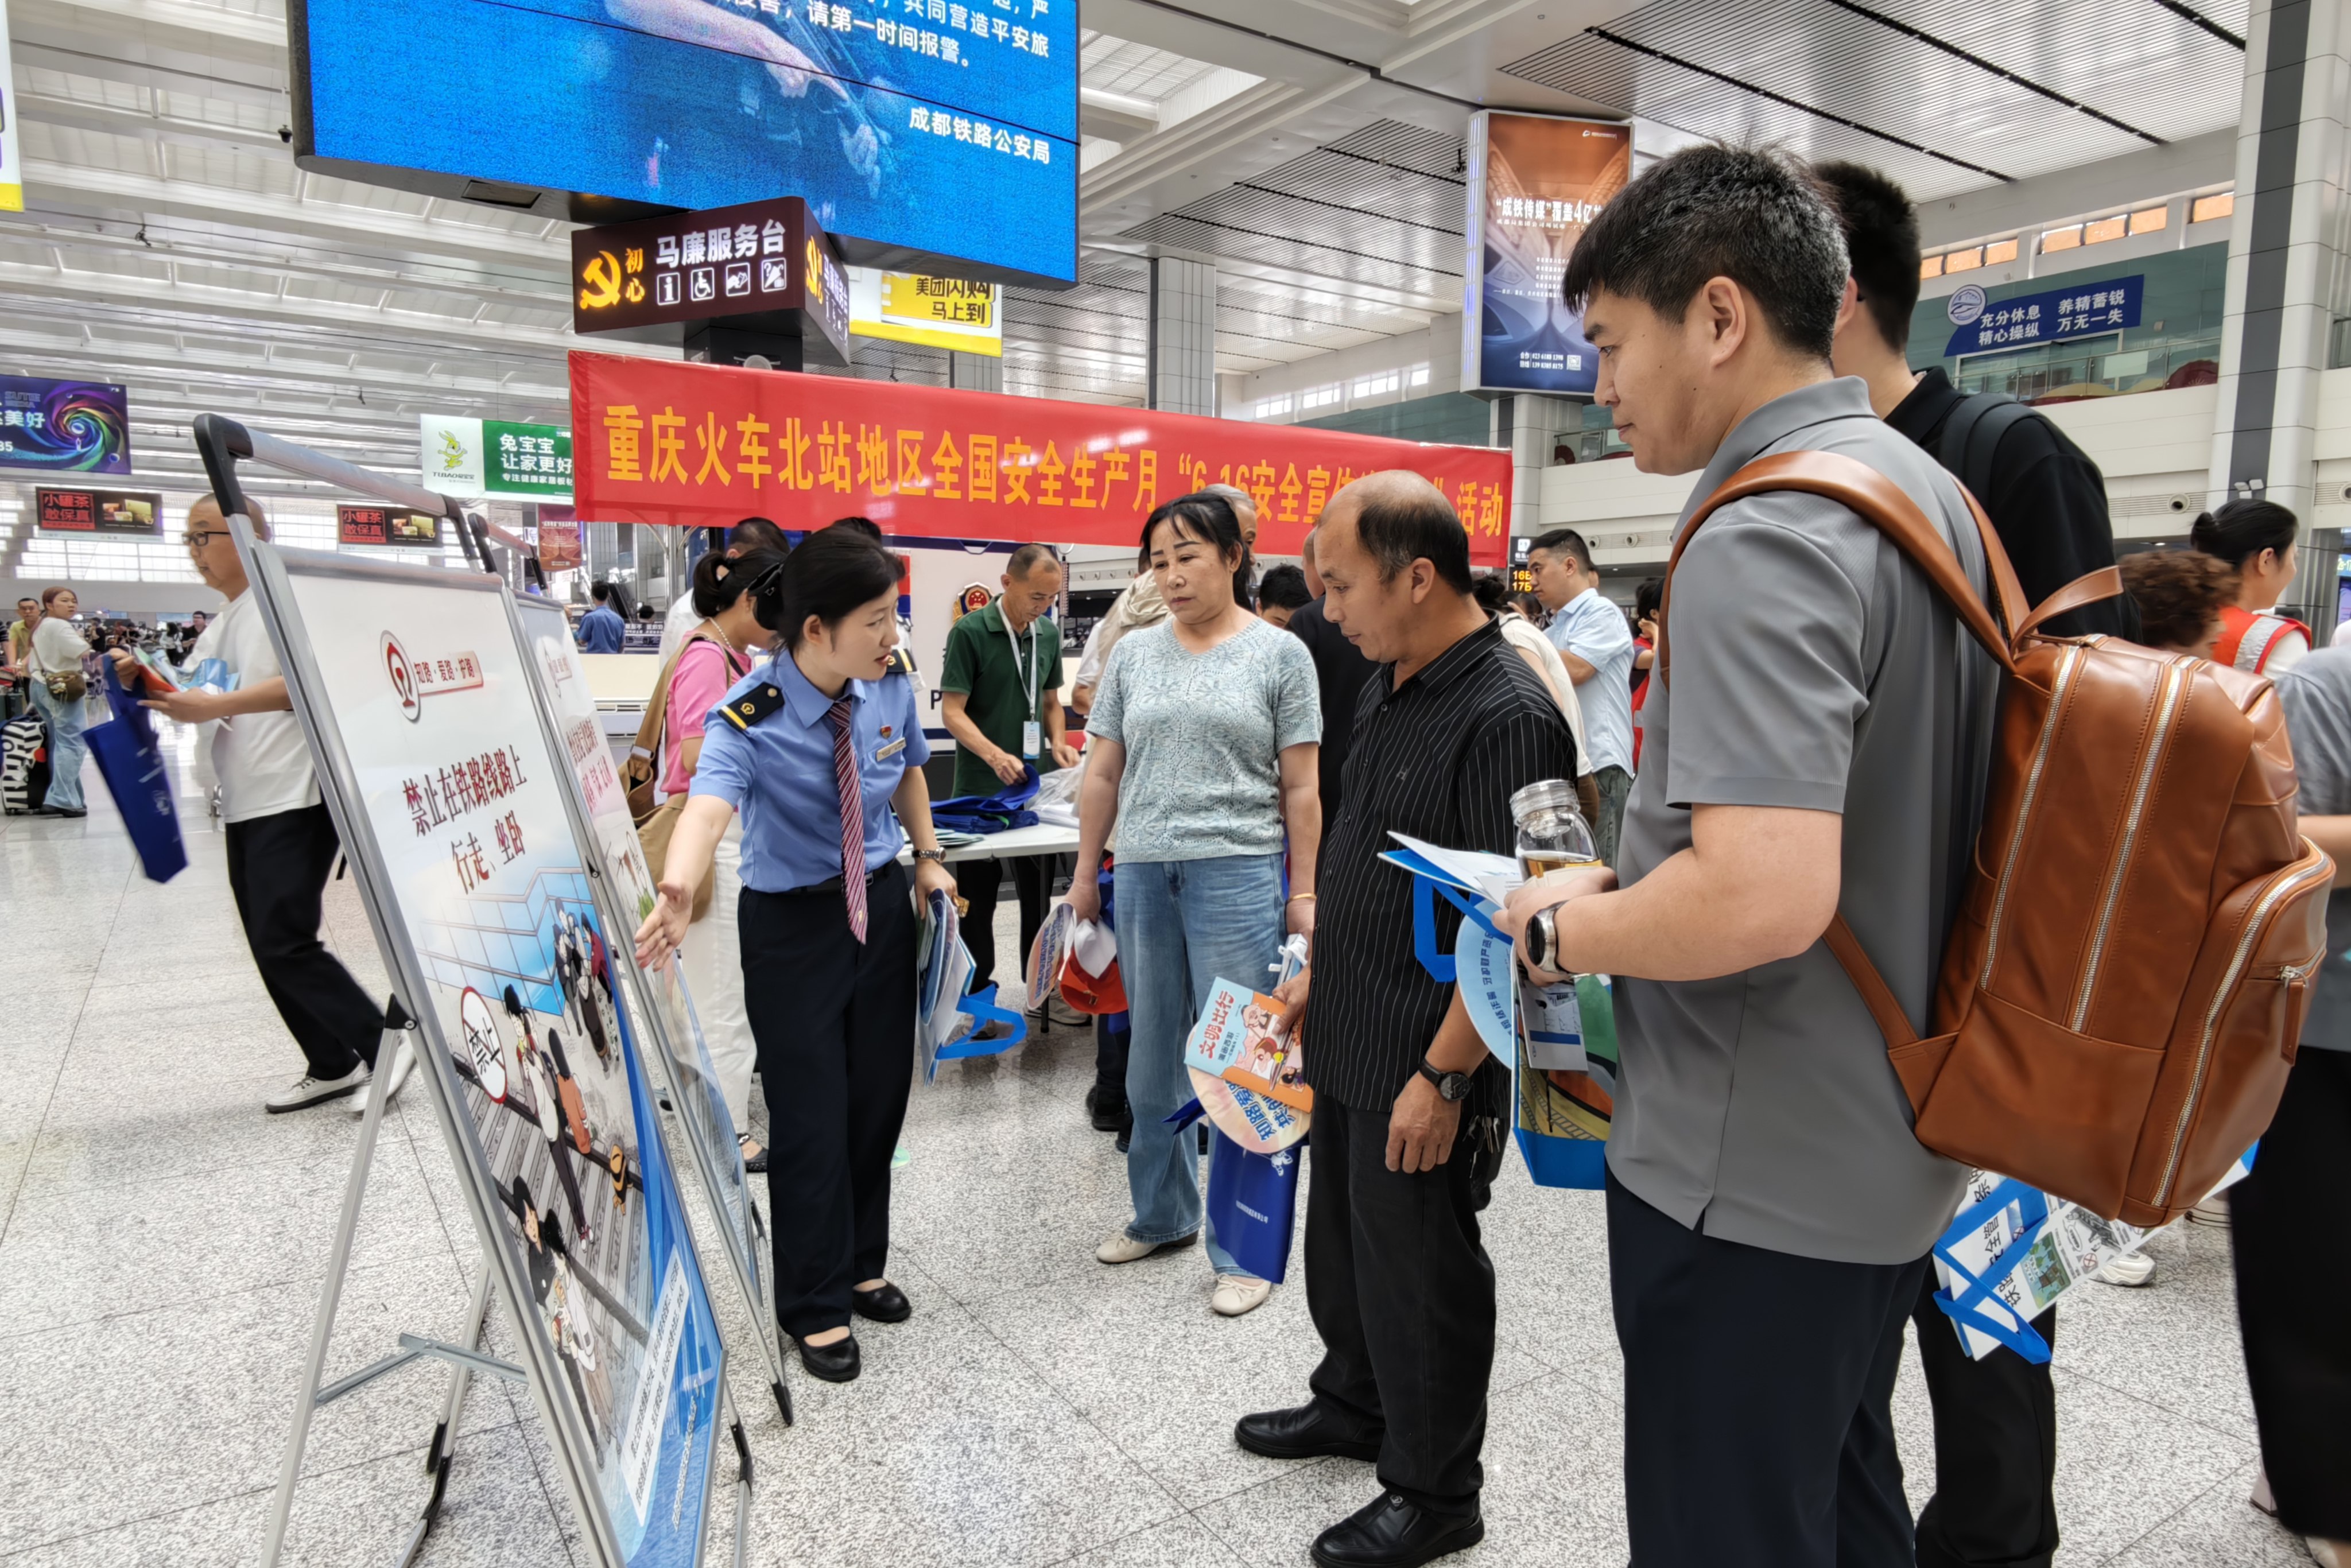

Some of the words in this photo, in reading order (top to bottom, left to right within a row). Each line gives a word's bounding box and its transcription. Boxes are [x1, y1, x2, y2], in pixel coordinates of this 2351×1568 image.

[909, 107, 1051, 165] 成都铁路公安局
[656, 219, 786, 269] 马廉服务台
[625, 247, 645, 303] 初心
[915, 277, 992, 300] 美团闪购
[931, 301, 986, 324] 马上到
[1978, 322, 2040, 347] 精心操纵
[2056, 308, 2124, 333] 万无一失
[1980, 304, 2041, 329] 充分休息
[2058, 289, 2125, 315] 养精蓄锐
[0, 410, 45, 428] 美好
[500, 433, 554, 454] 兔宝宝
[501, 453, 572, 474] 让家更好
[603, 405, 1157, 513] 重庆火车北站地区全国安全生产月
[1456, 481, 1503, 537] 活动
[403, 744, 527, 838] 禁止在铁路线路上
[451, 810, 526, 895] 行走、坐卧
[1198, 989, 1236, 1060] 文明出行
